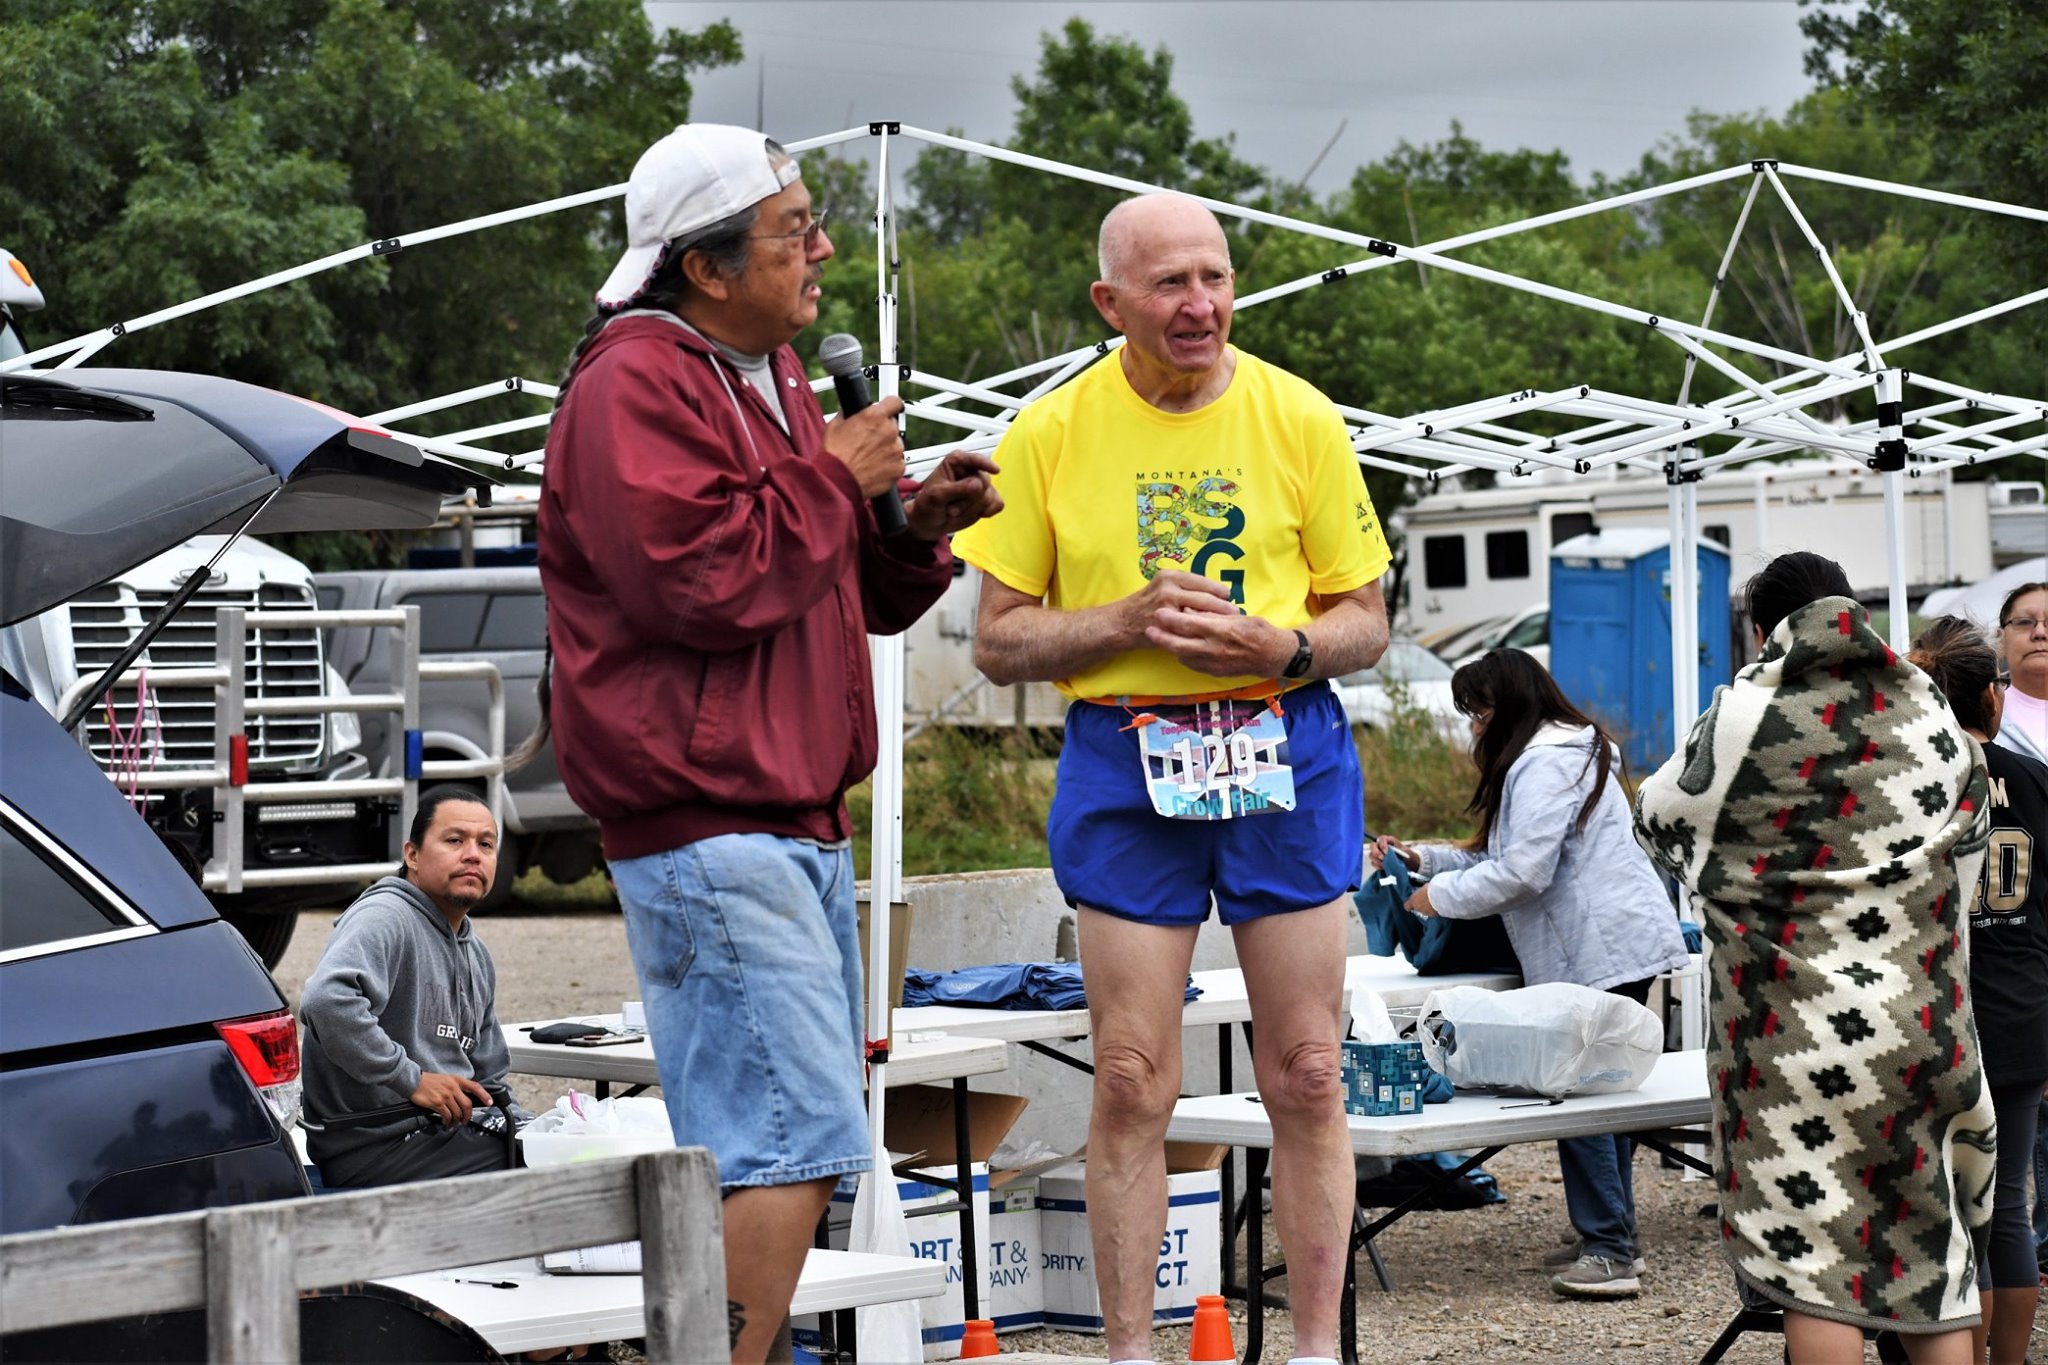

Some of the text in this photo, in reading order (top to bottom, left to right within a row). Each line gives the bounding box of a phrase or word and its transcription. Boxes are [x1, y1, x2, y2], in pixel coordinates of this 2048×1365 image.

[1136, 468, 1242, 480] MONTANA'S
[1242, 716, 1261, 727] Run
[1172, 732, 1258, 793] 129
[1172, 788, 1270, 816] Crow Fair
[1010, 1240, 1028, 1264] &
[1156, 1260, 1188, 1288] CT
